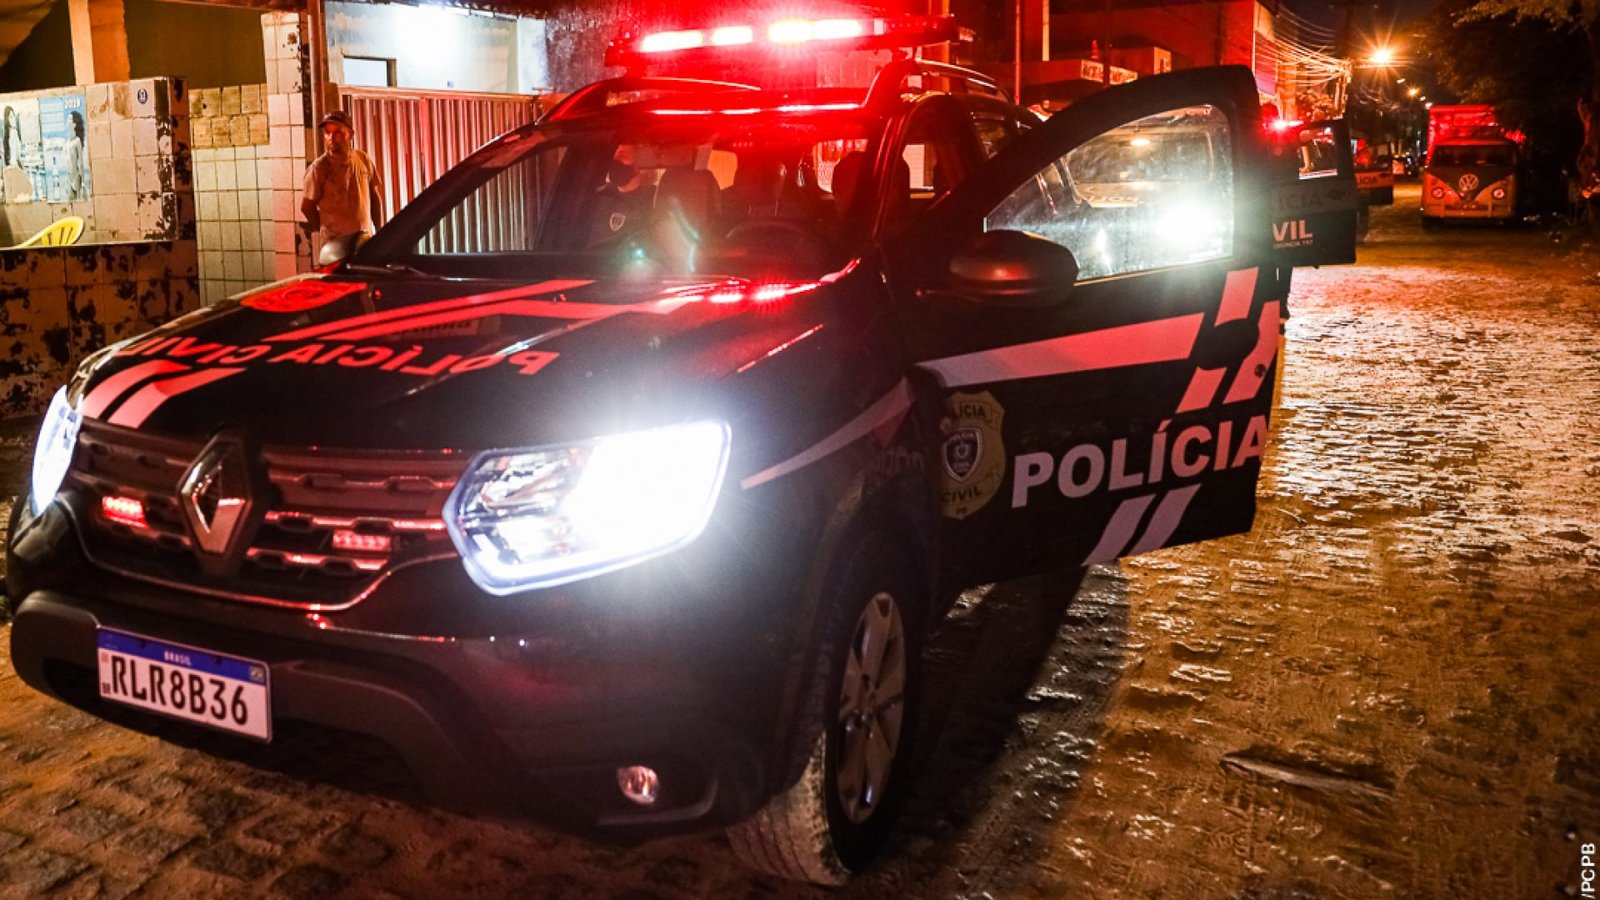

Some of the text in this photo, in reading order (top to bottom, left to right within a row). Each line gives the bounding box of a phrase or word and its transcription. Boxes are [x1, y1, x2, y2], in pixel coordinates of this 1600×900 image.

[1272, 219, 1314, 242] VIL
[951, 402, 986, 419] LÍCIA
[1012, 416, 1270, 508] POLÍCIA
[941, 485, 983, 503] CIVIL
[164, 650, 192, 667] BRASIL
[111, 655, 248, 726] RLR8B36
